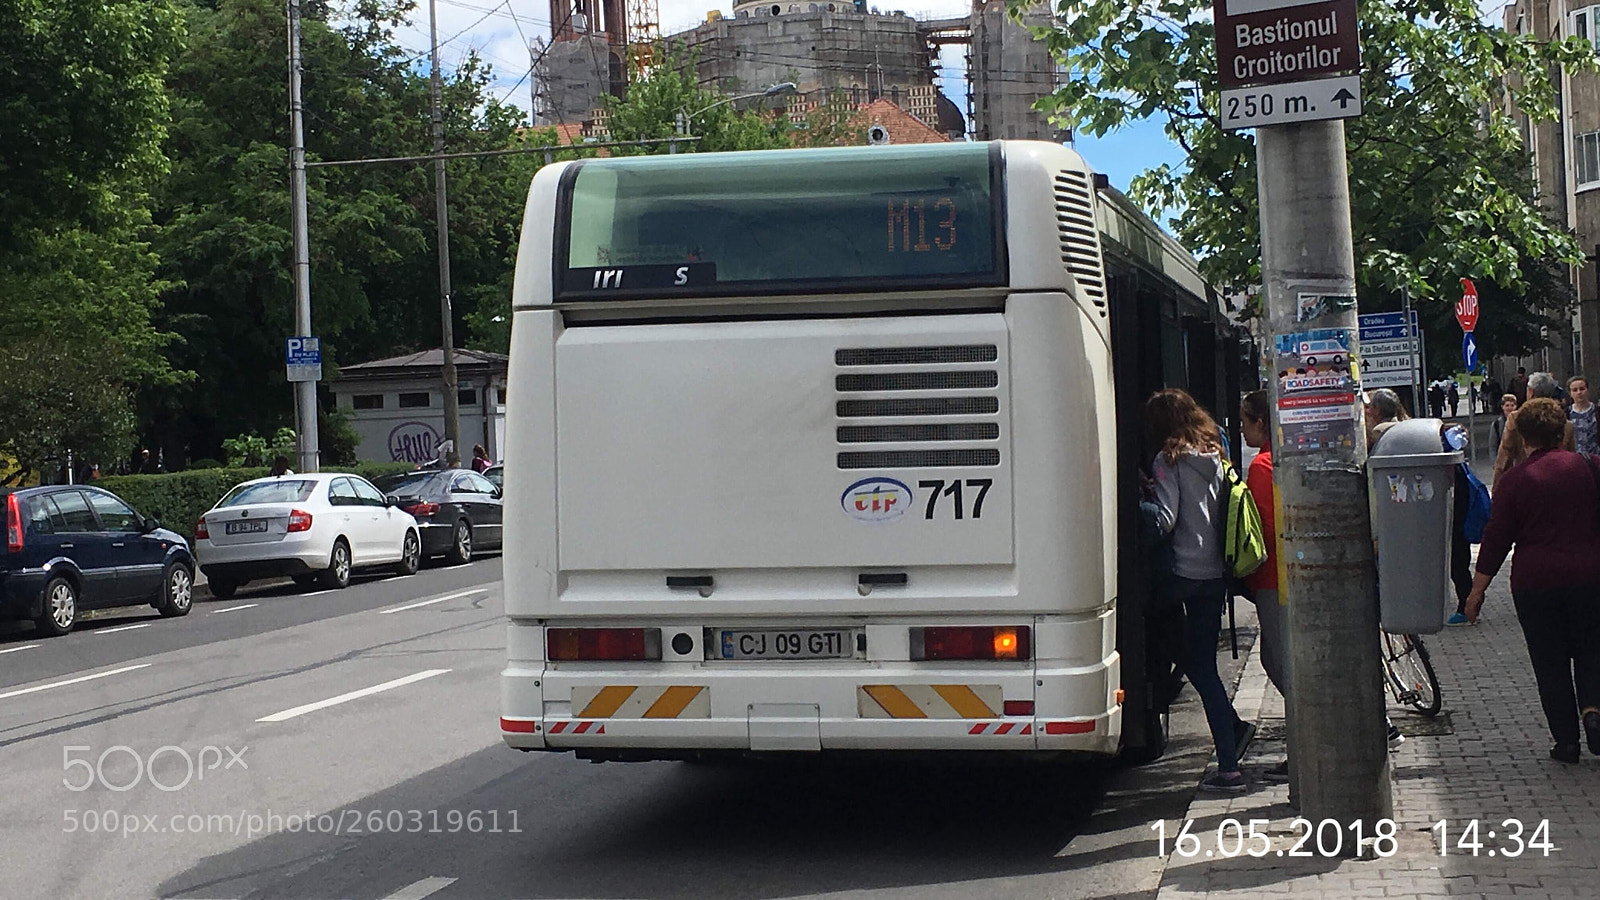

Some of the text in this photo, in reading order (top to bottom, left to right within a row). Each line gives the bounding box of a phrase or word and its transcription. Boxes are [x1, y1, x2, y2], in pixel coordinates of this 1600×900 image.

[1235, 11, 1337, 48] Bastionul
[1233, 45, 1342, 79] Croitorilor
[1227, 93, 1317, 120] 250 m.
[887, 197, 957, 252] M13
[1456, 294, 1478, 316] STOP
[287, 338, 302, 358] P
[1376, 359, 1398, 368] Iulius
[918, 478, 993, 520] 717
[739, 634, 767, 655] CJ
[775, 633, 801, 655] 09
[807, 632, 842, 654] GTI
